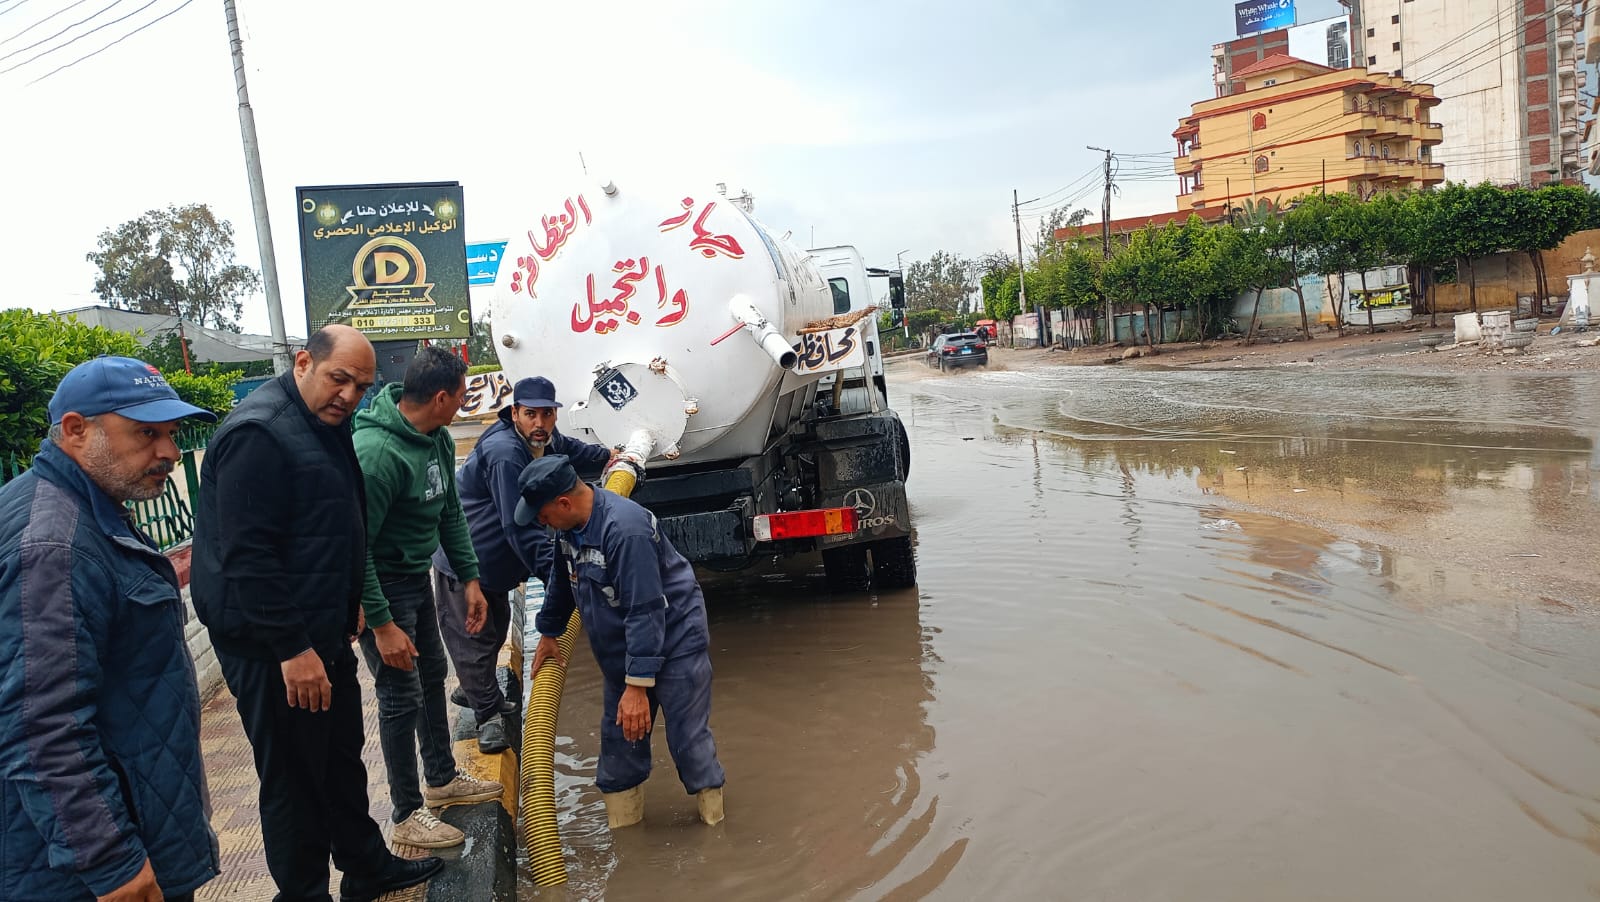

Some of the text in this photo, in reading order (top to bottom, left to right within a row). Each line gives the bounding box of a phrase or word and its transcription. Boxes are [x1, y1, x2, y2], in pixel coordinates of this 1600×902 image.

[1238, 7, 1258, 16] White
[1257, 2, 1278, 11] Whale
[356, 201, 419, 217] للإعلان هنا
[313, 224, 364, 240] الحصري
[418, 219, 457, 234] الوكيل
[510, 193, 592, 300] النظافة
[374, 251, 410, 284] D
[570, 255, 690, 335] والتجميل
[357, 319, 375, 327] 010
[413, 317, 431, 325] 333
